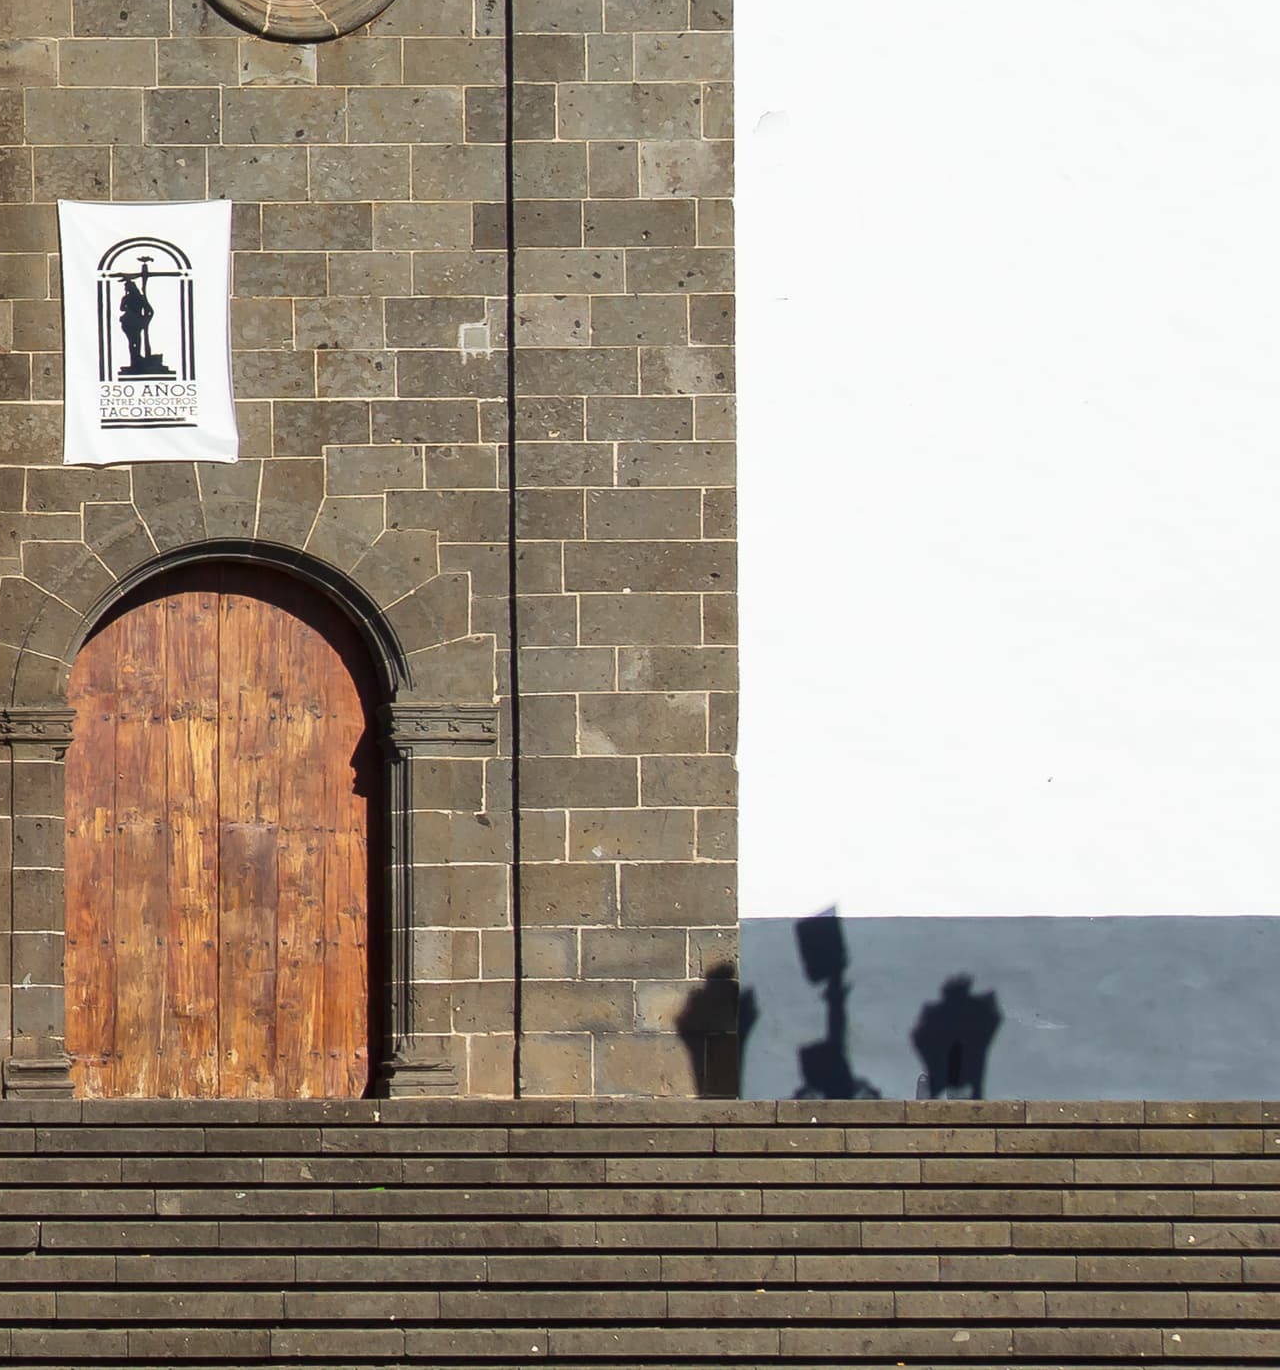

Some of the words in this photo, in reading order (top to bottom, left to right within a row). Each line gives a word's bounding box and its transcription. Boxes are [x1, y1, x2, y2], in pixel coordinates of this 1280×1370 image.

[100, 385, 135, 397] 350
[141, 382, 198, 397] AÑOS
[99, 398, 135, 407] ENTRE
[137, 397, 198, 406] NOSOTROS
[99, 406, 198, 418] TACORONTE
